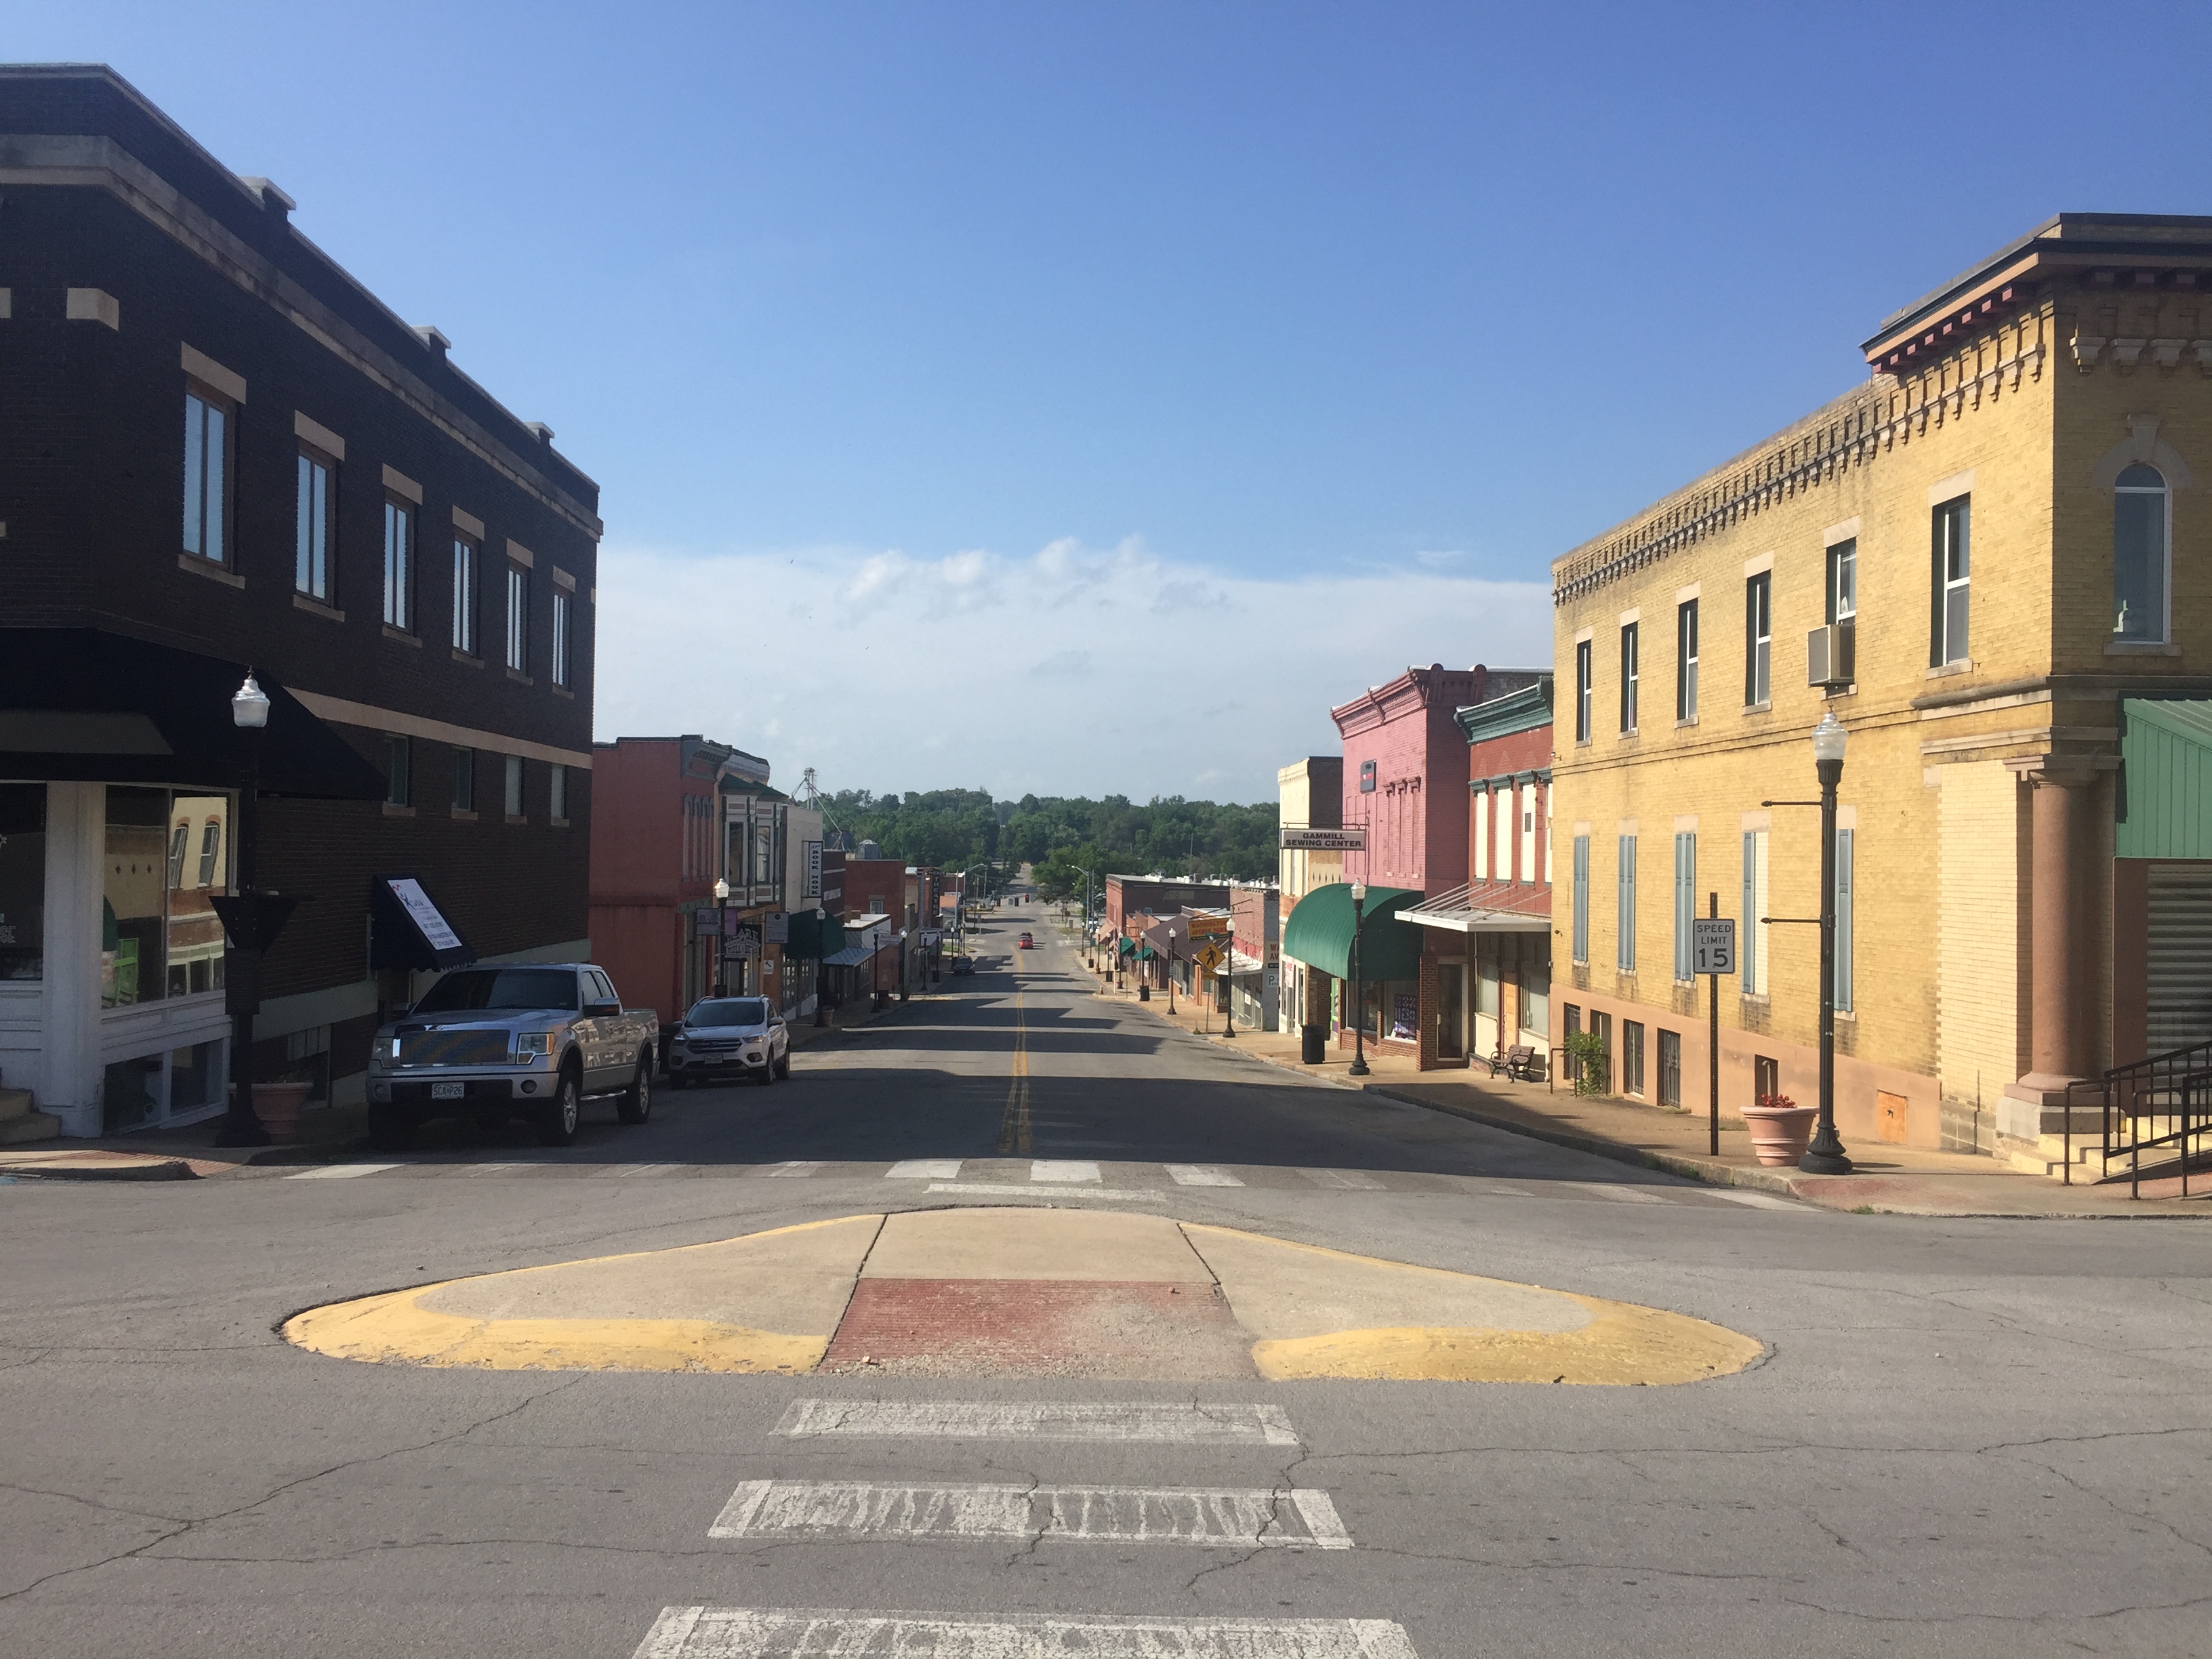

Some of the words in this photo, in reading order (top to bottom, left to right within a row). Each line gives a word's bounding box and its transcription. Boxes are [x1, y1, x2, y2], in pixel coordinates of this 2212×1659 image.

[1697, 924, 1731, 933] SPEED
[1701, 936, 1727, 944] LIMIT
[1699, 948, 1728, 968] 15
